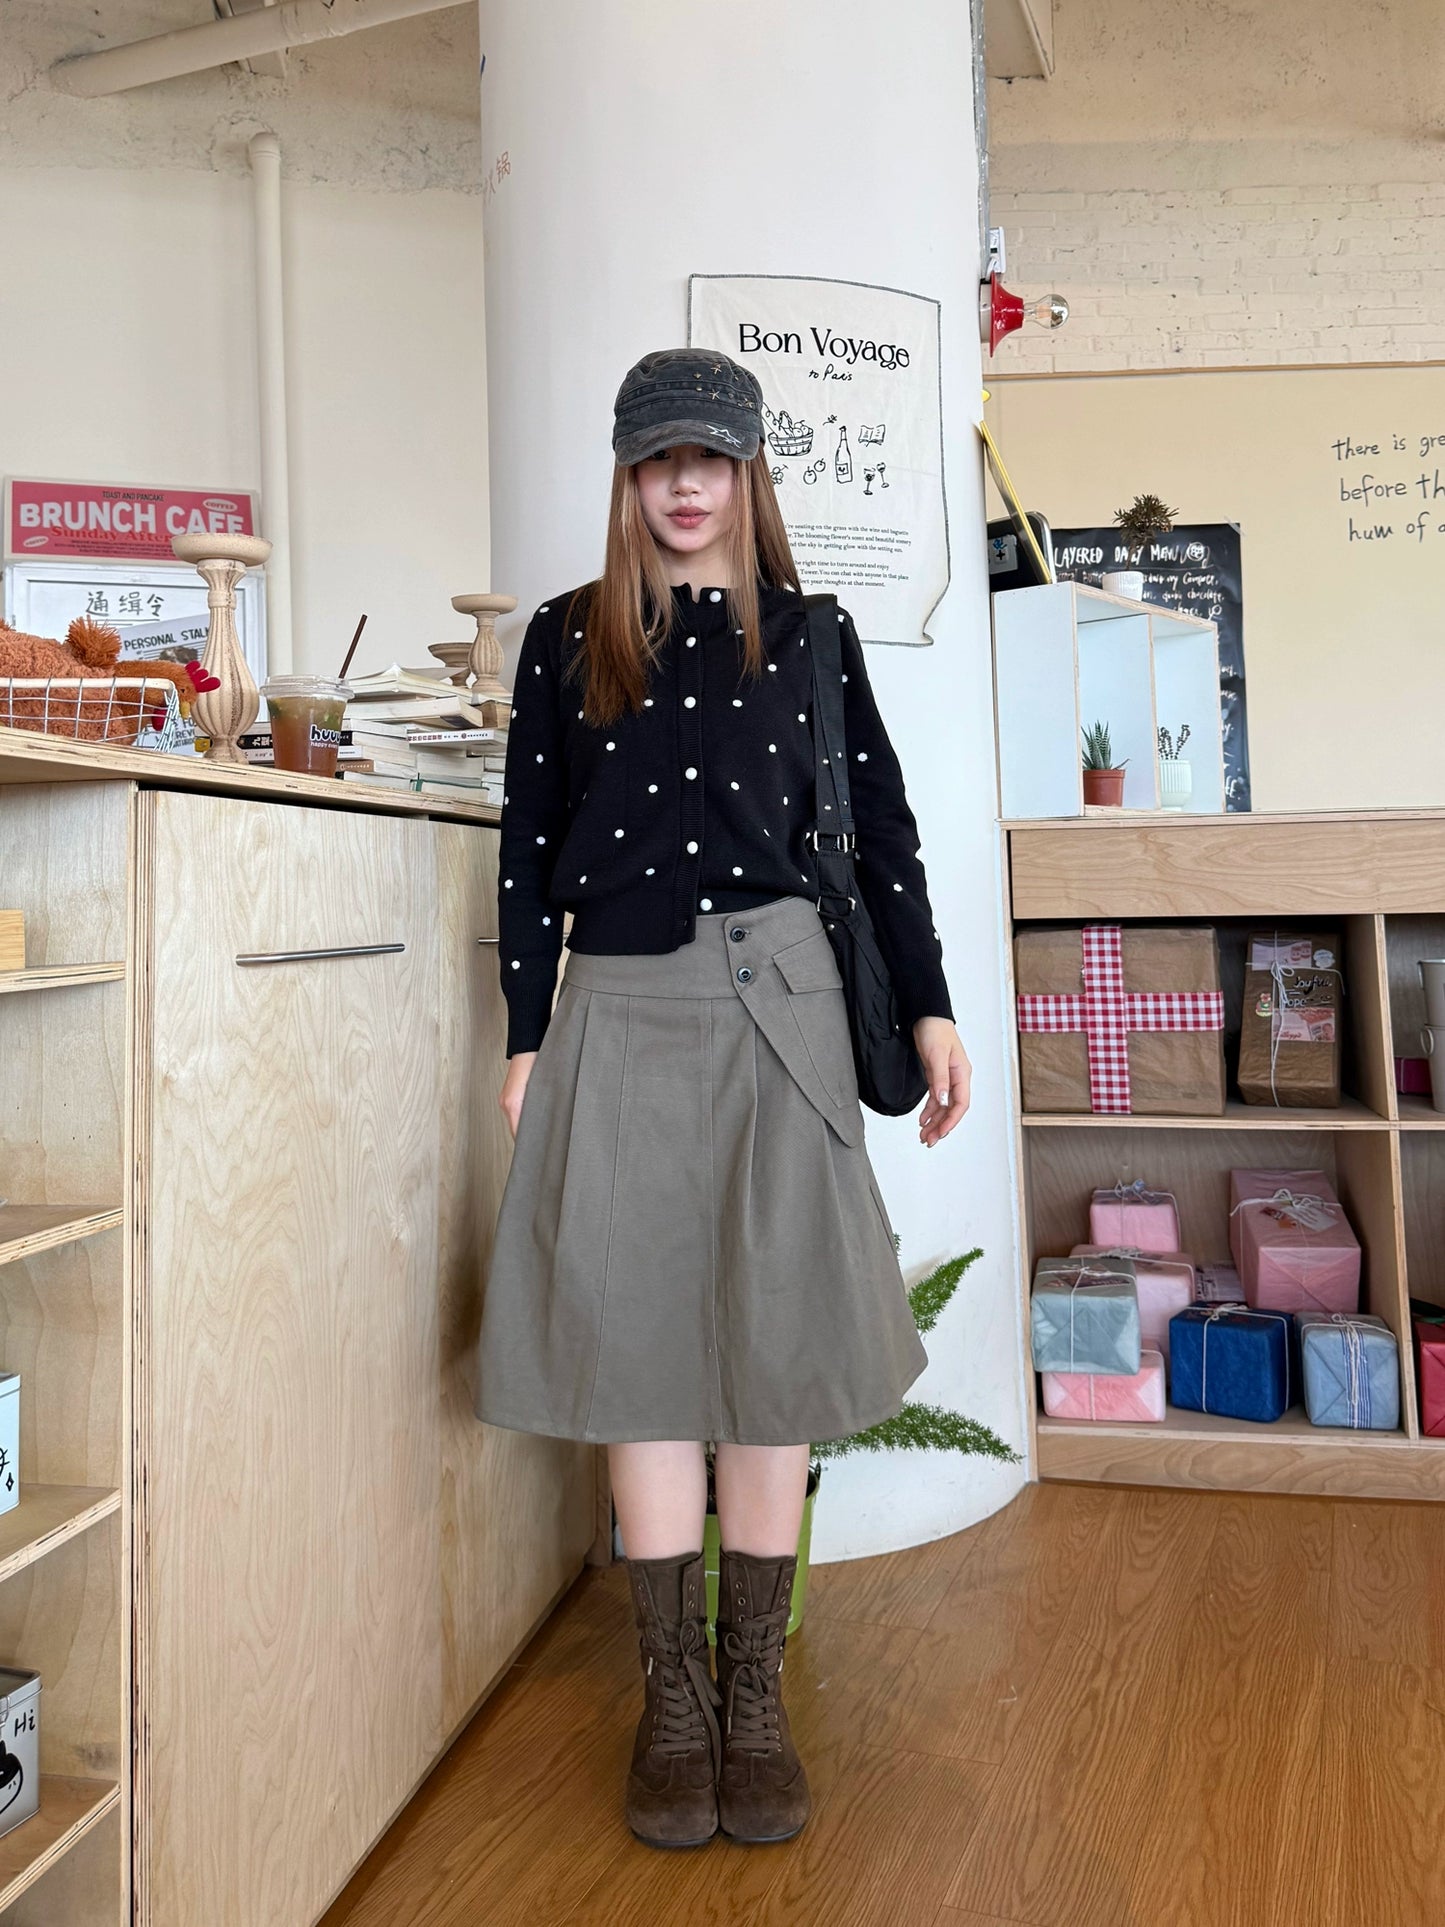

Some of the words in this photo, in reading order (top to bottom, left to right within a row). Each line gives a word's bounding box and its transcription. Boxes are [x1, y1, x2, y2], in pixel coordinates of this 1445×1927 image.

[738, 323, 802, 354] Bon
[810, 327, 910, 370] Voyage
[808, 370, 819, 378] to
[823, 363, 853, 381] Paris
[1331, 437, 1381, 460] there
[1392, 433, 1407, 450] is
[102, 491, 121, 499] TOAST
[1340, 474, 1408, 508] before
[20, 500, 156, 535] BRUNCH
[166, 505, 244, 536] CAFE
[1348, 517, 1394, 541] hum
[1405, 511, 1431, 543] of
[50, 526, 117, 541] Sunday
[126, 530, 172, 542] After
[806, 532, 830, 540] blooming
[802, 559, 817, 568] right
[1054, 546, 1104, 570] LAYERED
[1150, 543, 1180, 562] MENU
[823, 578, 847, 586] thoughts
[86, 590, 164, 617] 通缉令
[124, 632, 177, 651] PERSONAL
[14, 1708, 36, 1738] Hi
